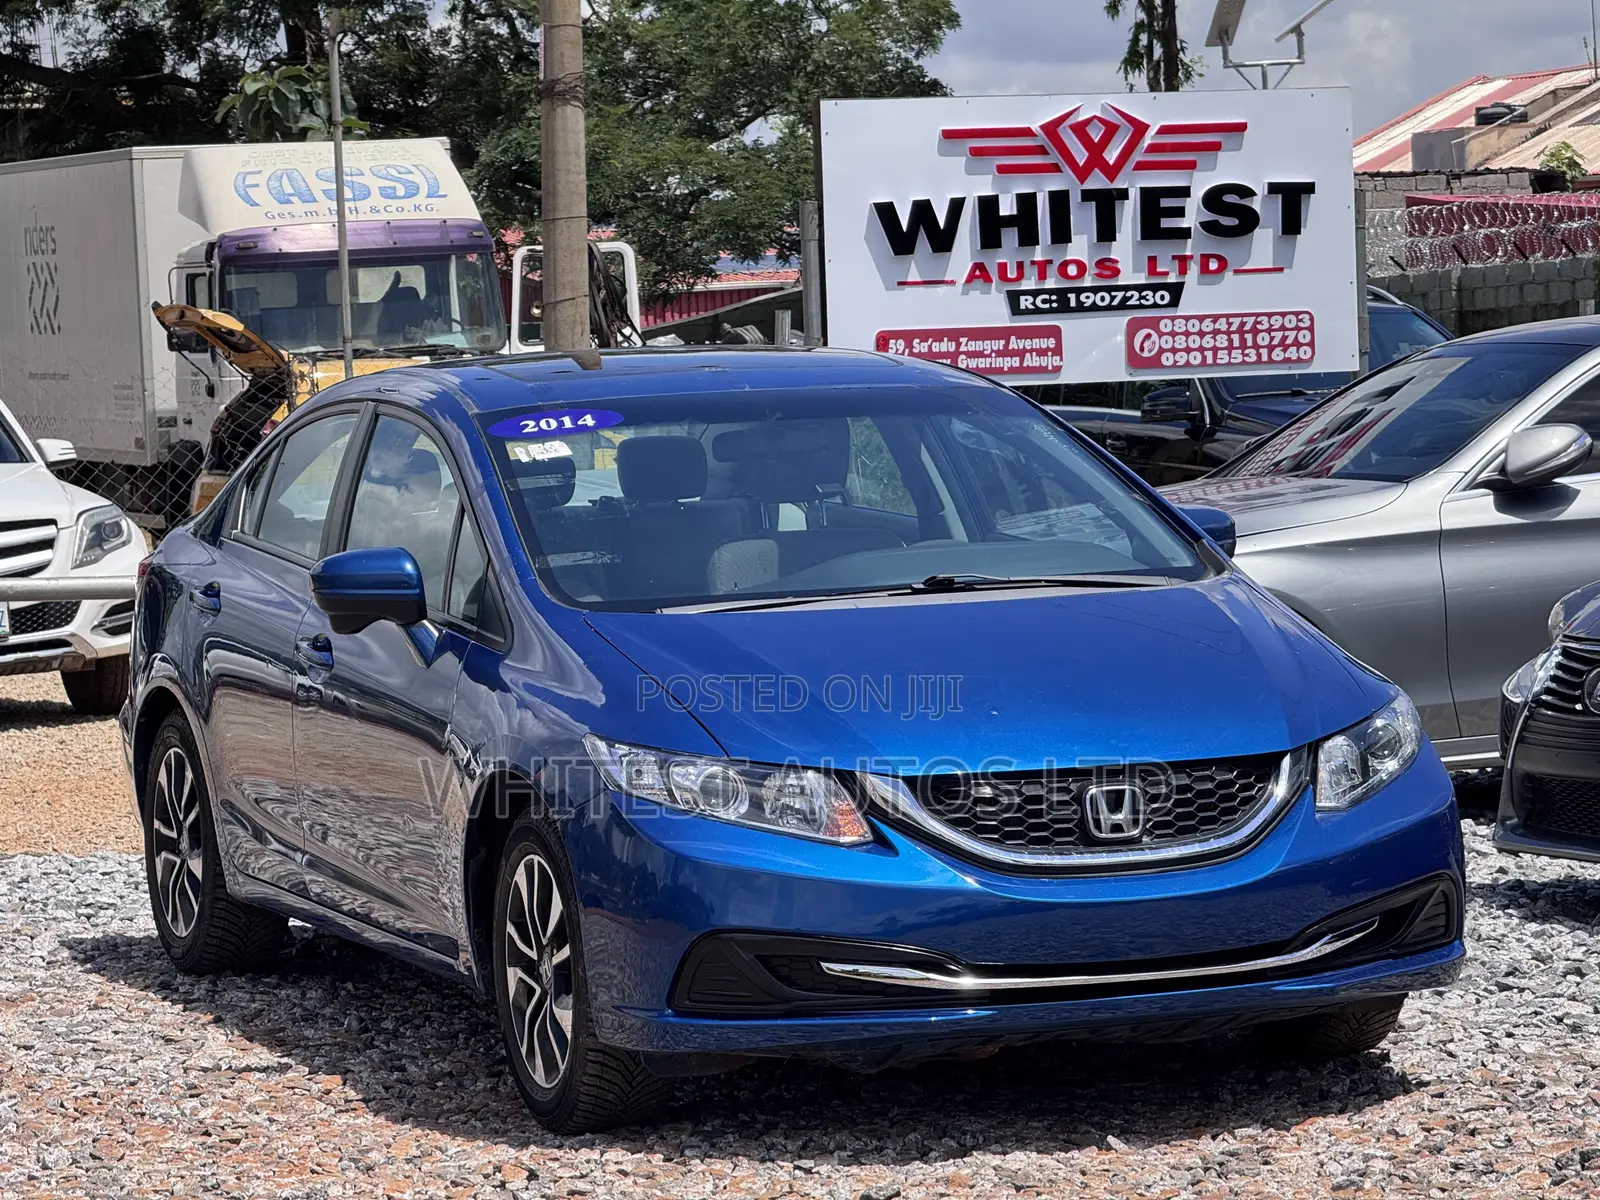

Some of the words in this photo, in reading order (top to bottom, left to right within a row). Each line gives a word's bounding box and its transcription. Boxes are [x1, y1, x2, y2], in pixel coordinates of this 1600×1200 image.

[872, 181, 1316, 257] WHITEST
[963, 256, 1122, 284] AUTOS
[1146, 252, 1229, 277] LTD
[1019, 293, 1058, 310] RC:
[1067, 290, 1171, 307] 1907230
[1159, 314, 1312, 333] 08064773903
[888, 338, 909, 356] 59,
[959, 337, 1006, 354] Zangur
[1008, 336, 1056, 350] Avenue
[1159, 330, 1312, 349] 08068110770
[957, 354, 1020, 371] Gwarinpa
[1023, 351, 1065, 370] Abuja.
[1160, 346, 1313, 366] 09015531640
[519, 414, 596, 433] 2014
